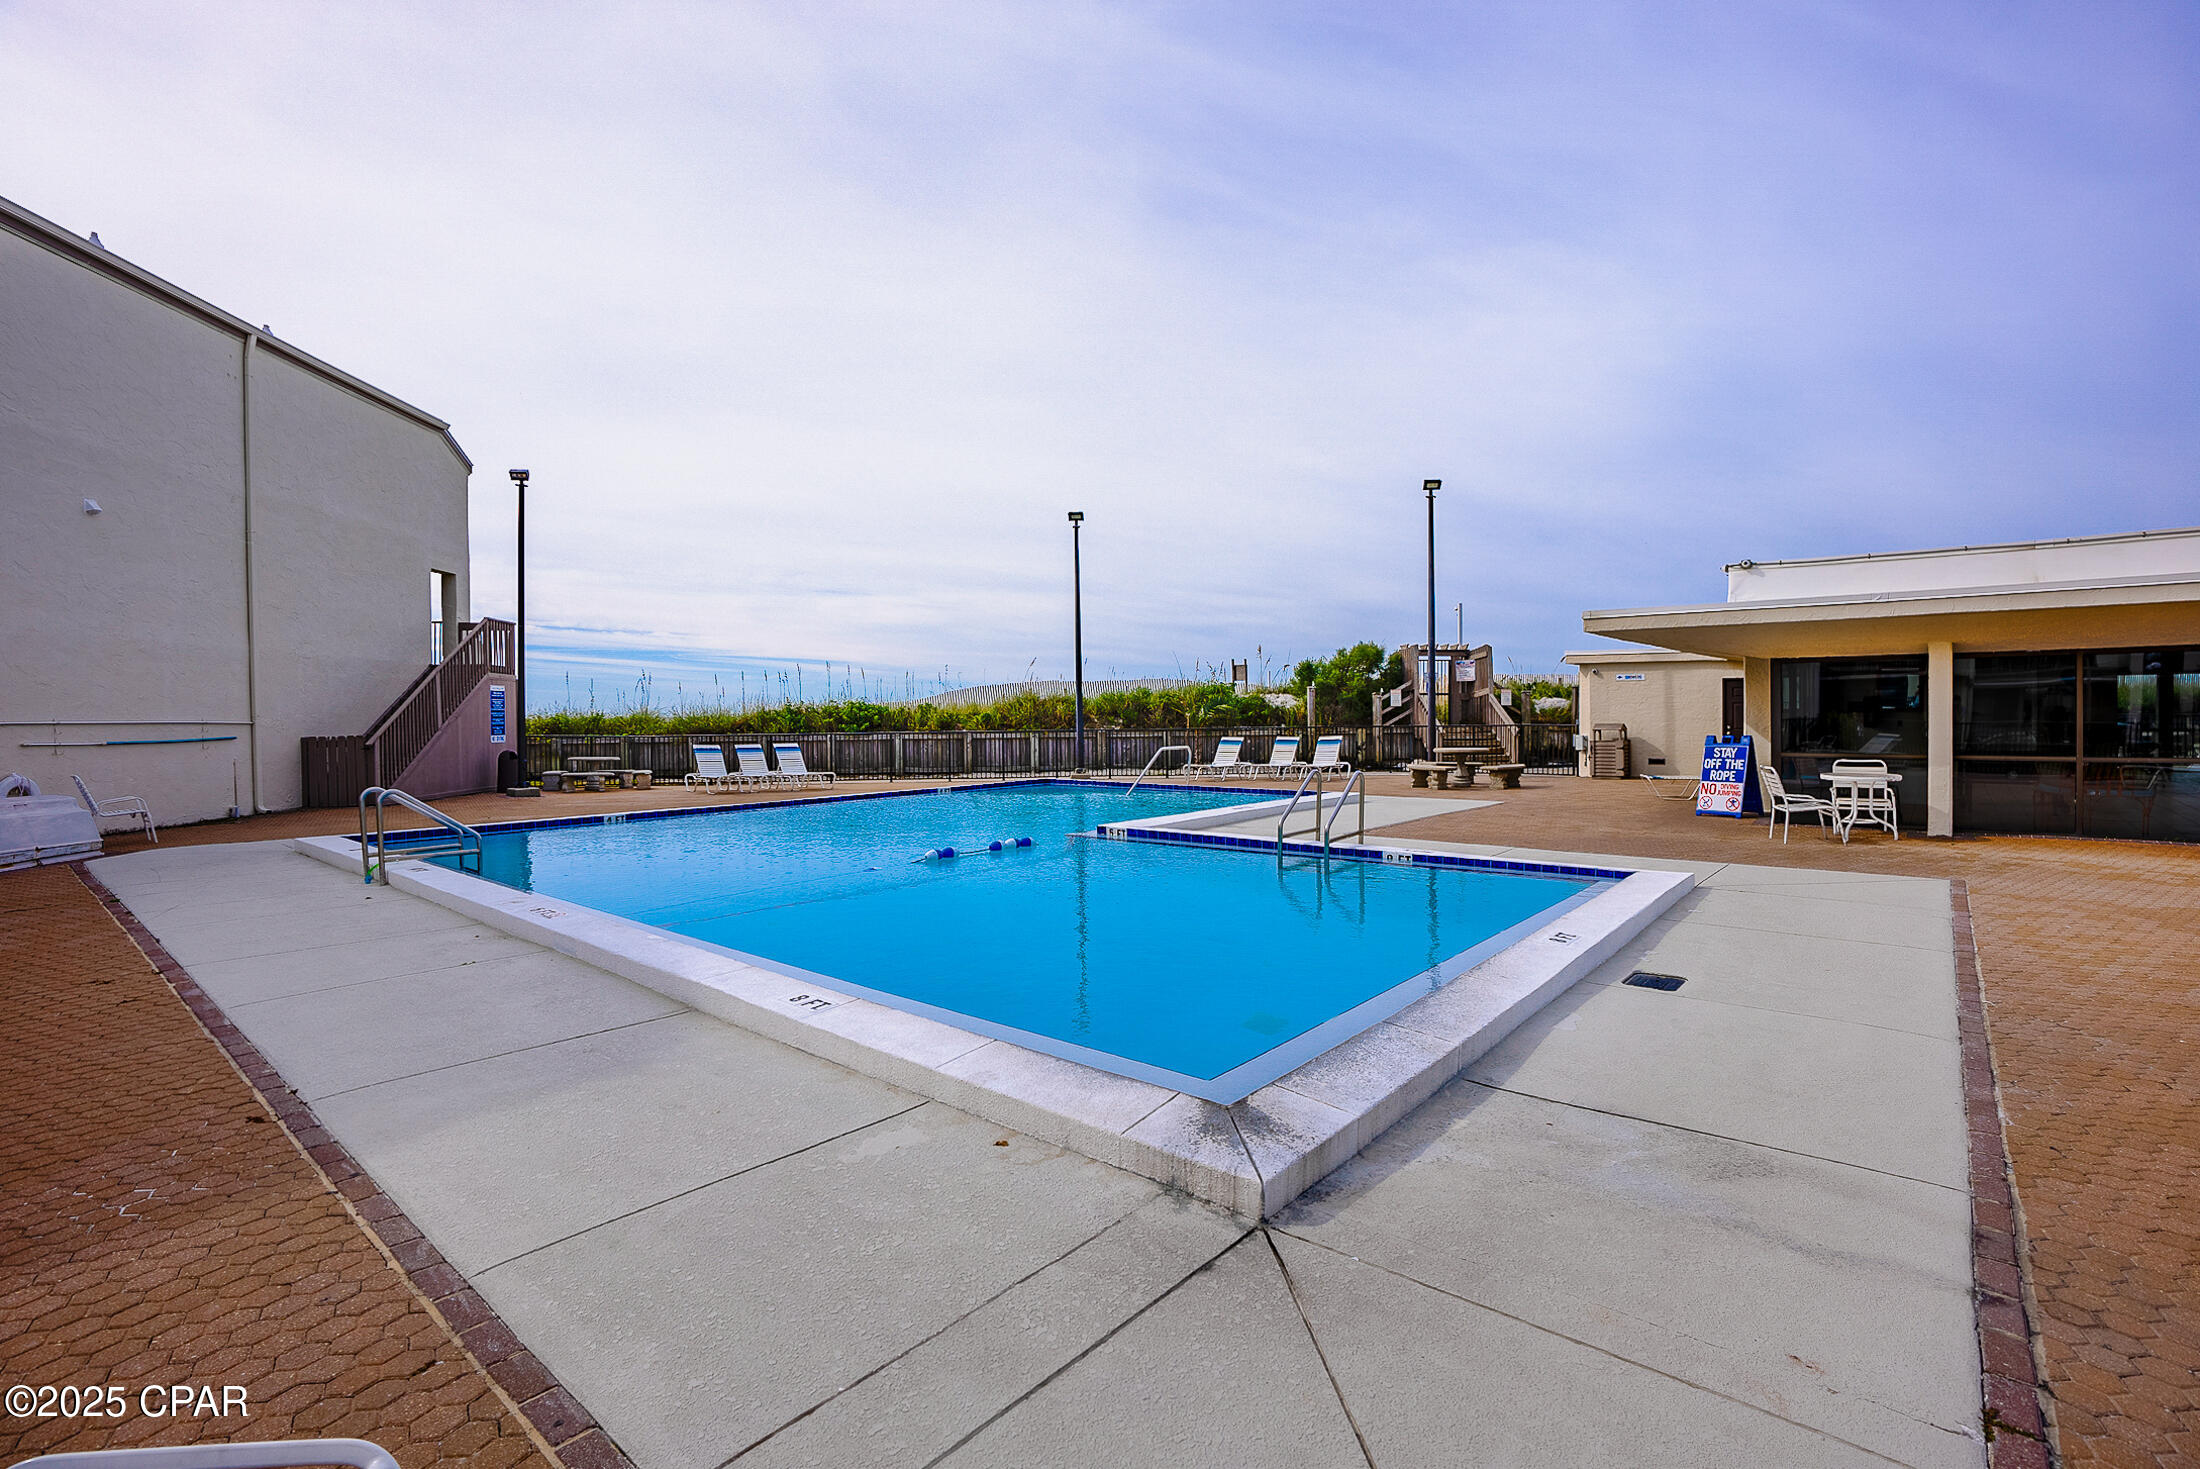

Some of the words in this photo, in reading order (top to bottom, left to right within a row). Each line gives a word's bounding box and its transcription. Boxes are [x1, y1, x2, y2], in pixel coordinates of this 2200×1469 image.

[1713, 747, 1738, 758] STAY
[1704, 758, 1723, 769] OFF
[1725, 759, 1745, 770] THE
[1709, 770, 1737, 782] ROPE
[1700, 782, 1717, 795] NO
[1116, 829, 1126, 838] FT
[789, 994, 810, 1002] 8
[800, 998, 832, 1010] FT
